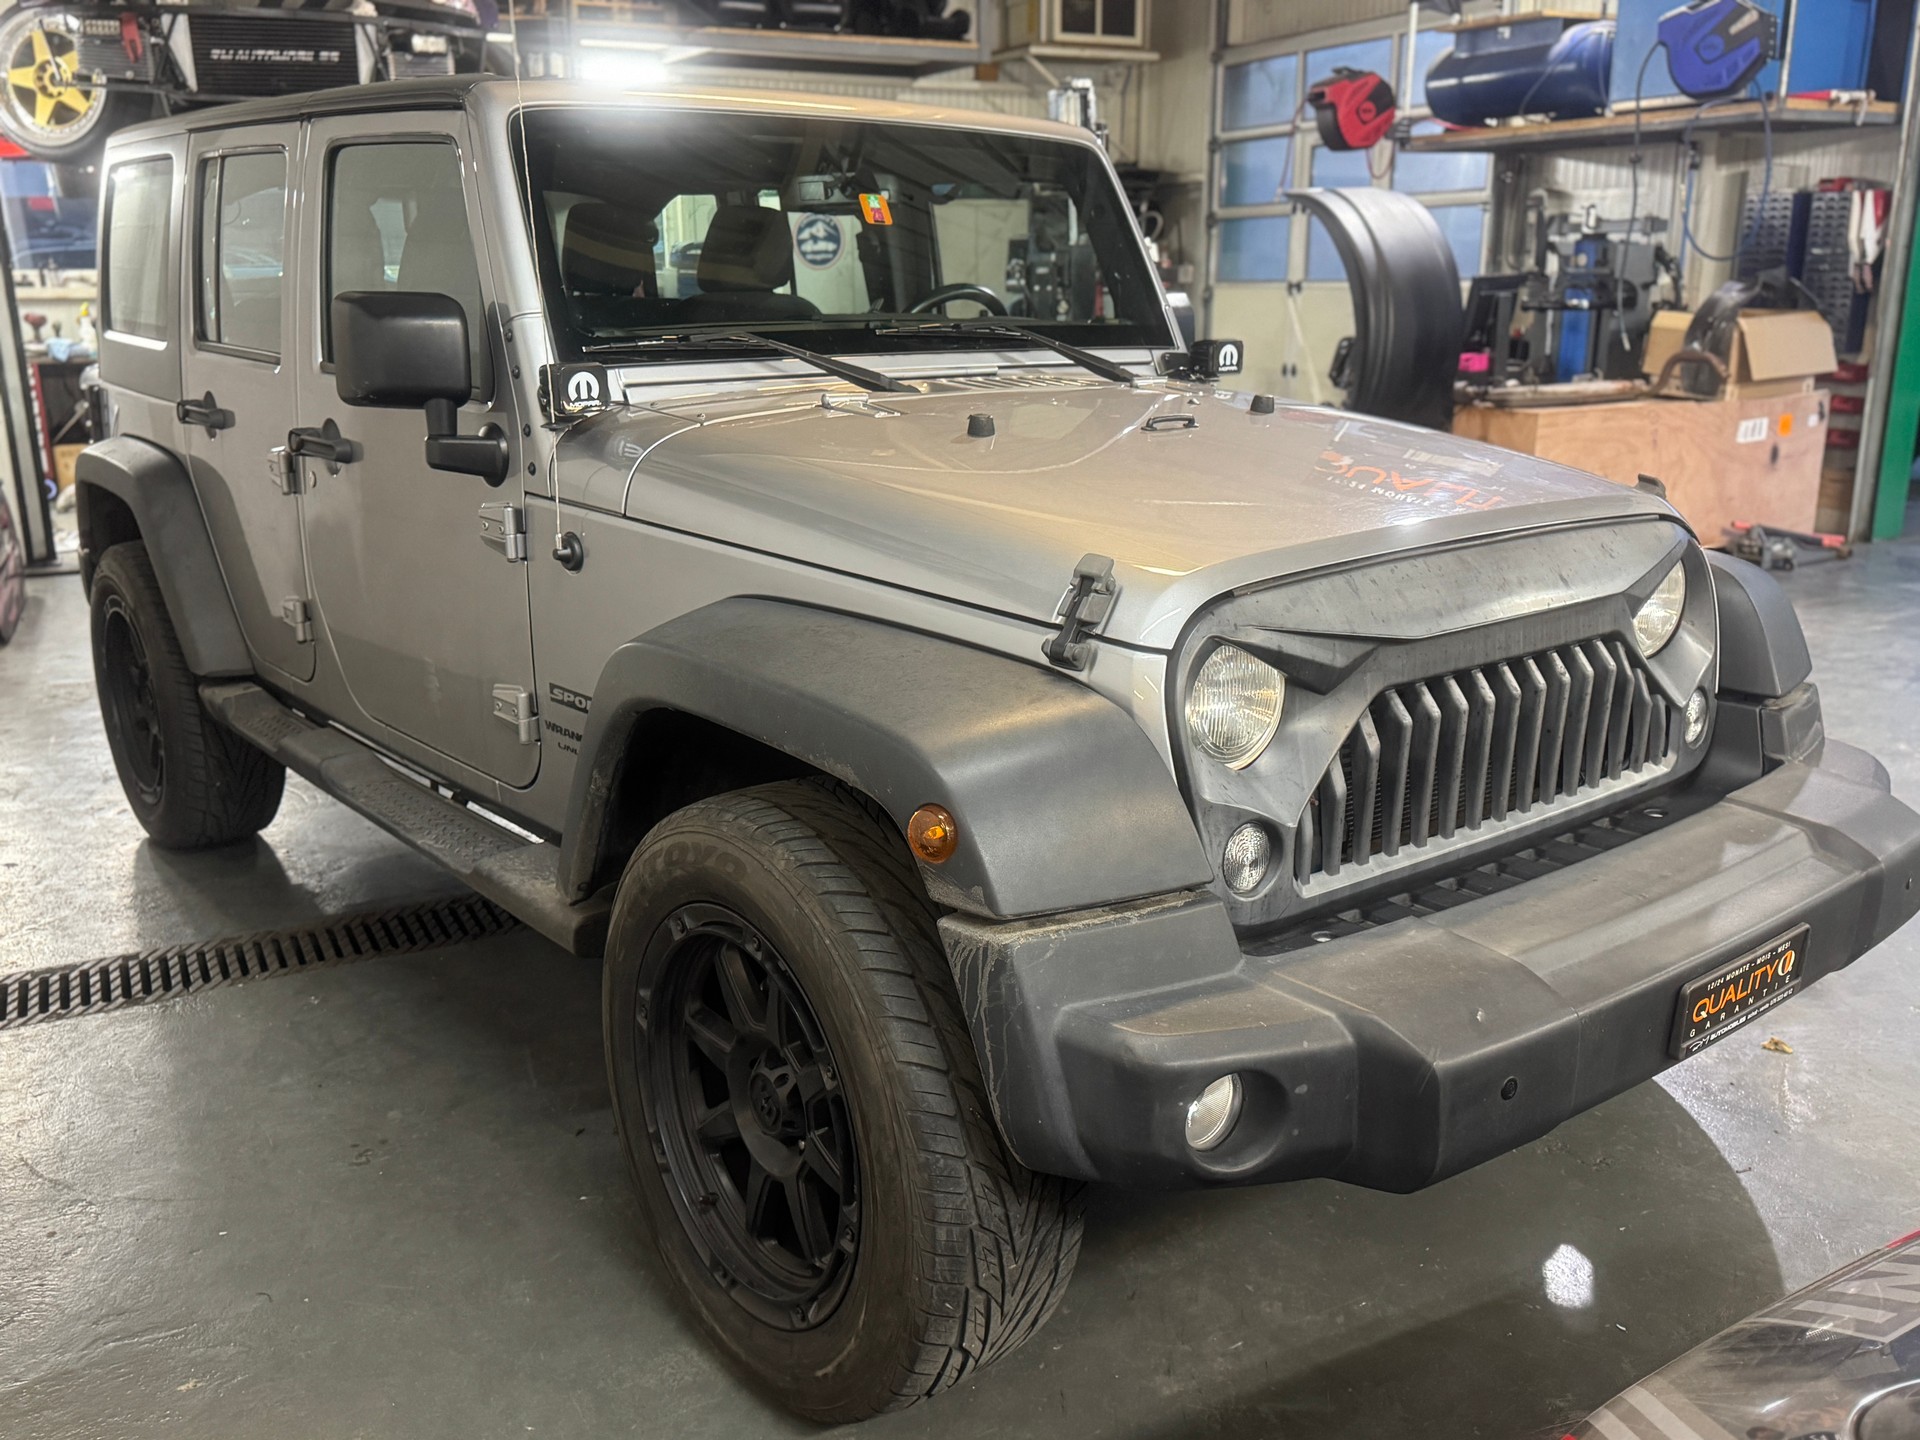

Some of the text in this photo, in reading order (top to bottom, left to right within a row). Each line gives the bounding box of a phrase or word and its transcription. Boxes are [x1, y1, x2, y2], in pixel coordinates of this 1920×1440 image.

[1725, 963, 1751, 981] MONATE
[1756, 952, 1771, 965] MOIS
[1777, 941, 1791, 953] MESI
